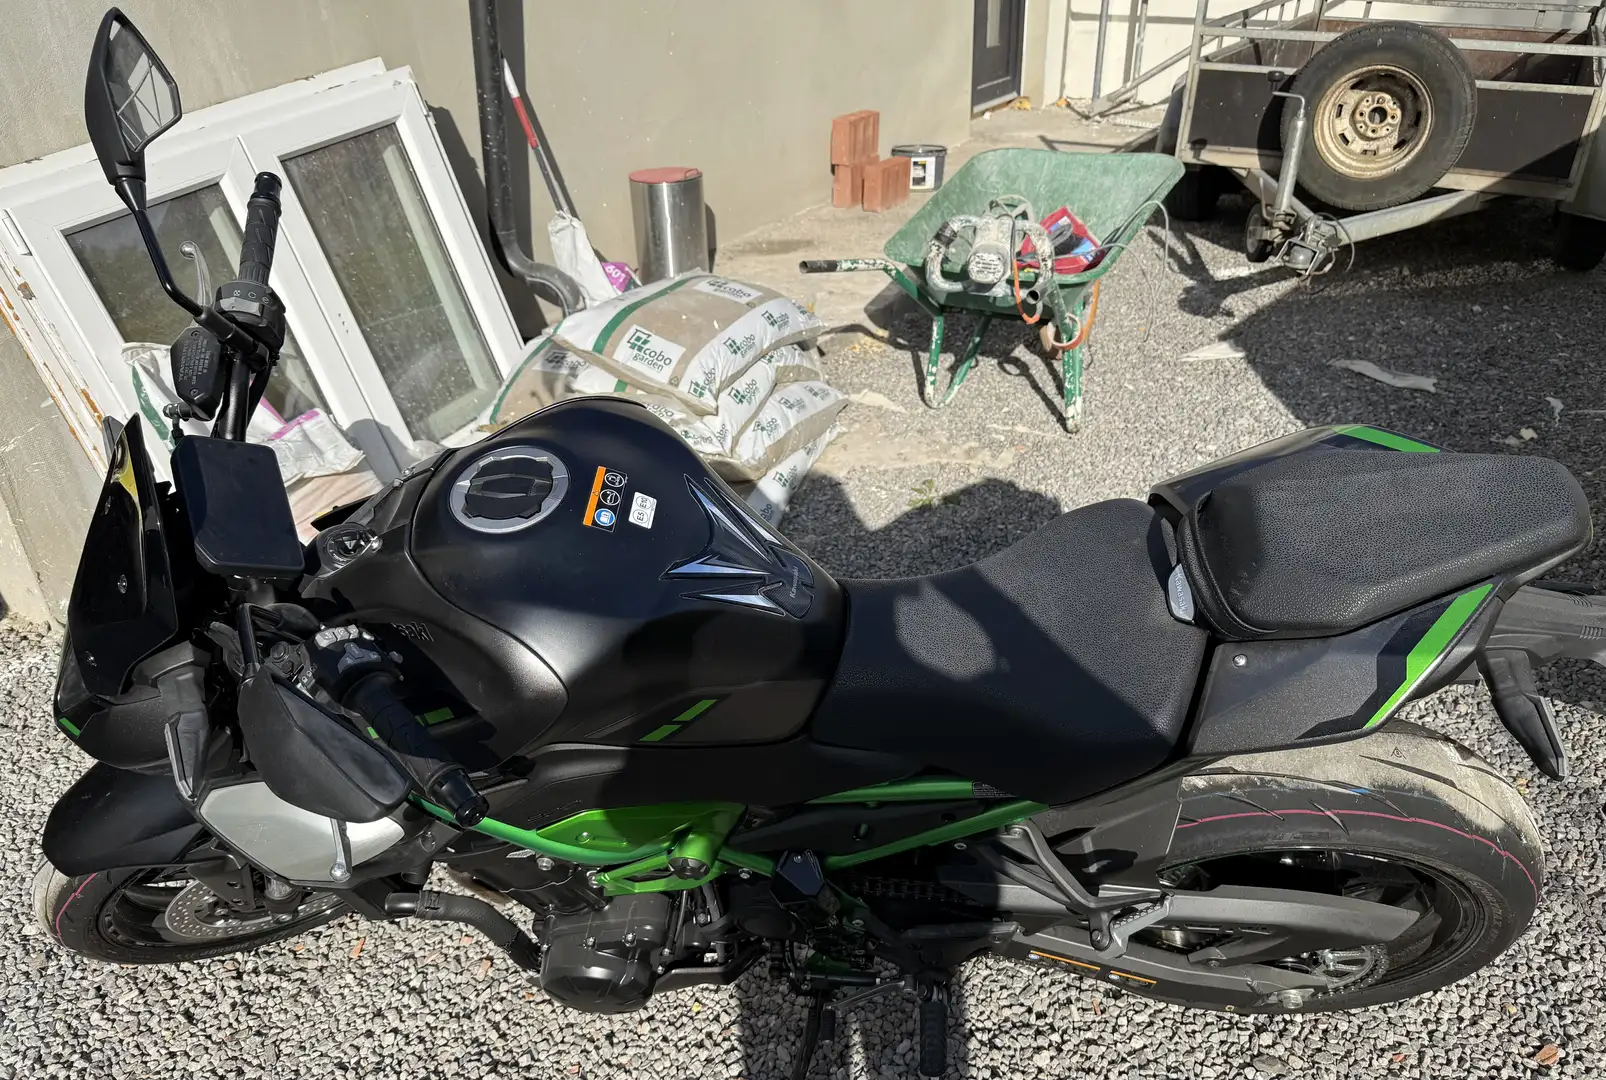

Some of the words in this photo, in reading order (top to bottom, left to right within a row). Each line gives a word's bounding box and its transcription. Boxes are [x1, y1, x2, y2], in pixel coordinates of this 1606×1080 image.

[723, 286, 751, 297] cobo
[740, 333, 756, 349] cobo
[632, 352, 665, 372] garden
[643, 347, 673, 366] cobo
[639, 497, 648, 509] E10
[636, 511, 645, 522] E5
[760, 503, 773, 520] obo
[1174, 572, 1188, 614] Kawasaki
